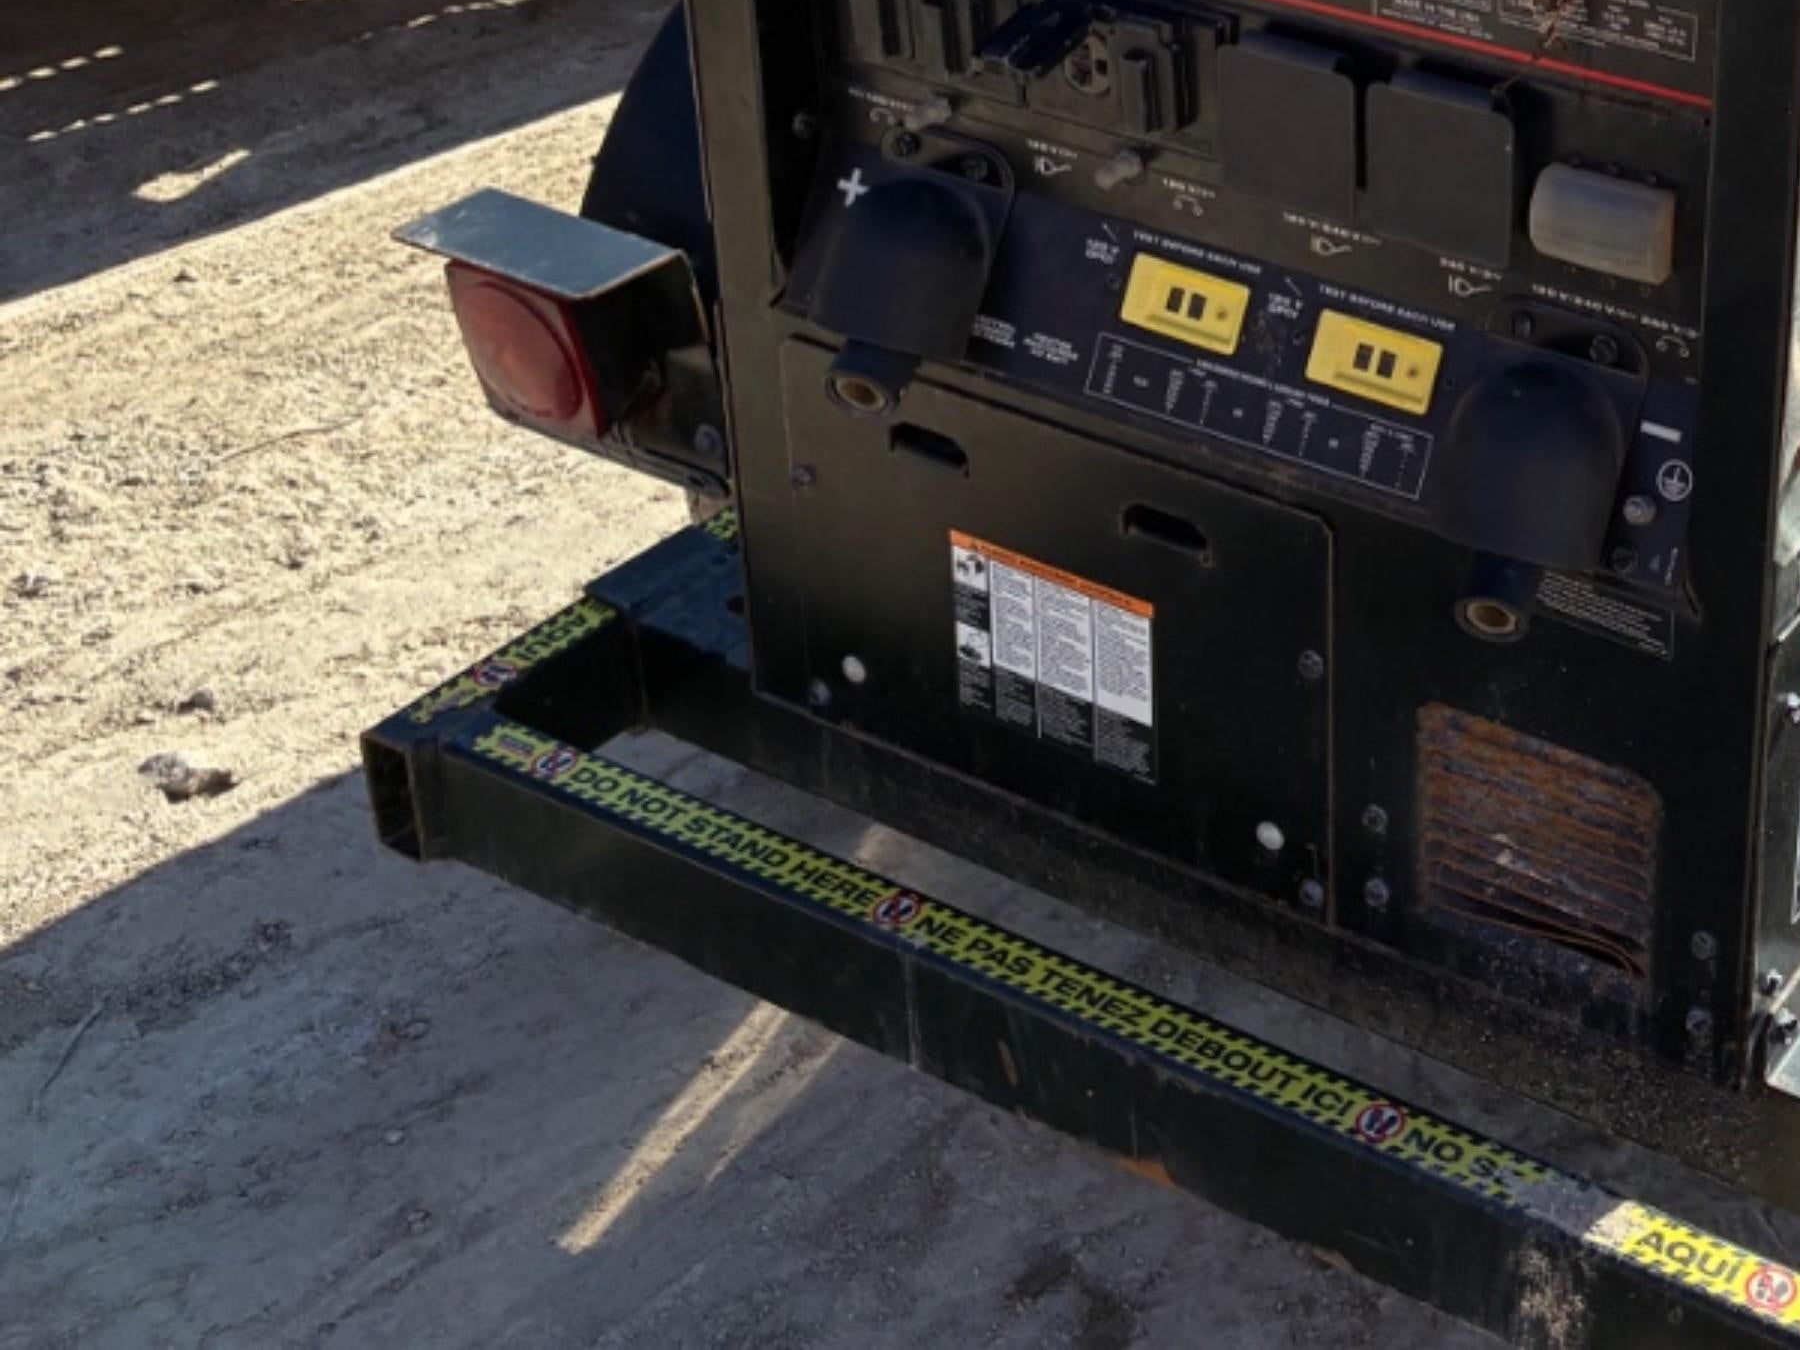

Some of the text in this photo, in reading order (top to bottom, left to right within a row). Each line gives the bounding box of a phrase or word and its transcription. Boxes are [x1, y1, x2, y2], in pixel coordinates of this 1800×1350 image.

[566, 764, 879, 906] DO NOT STAND HERE
[914, 914, 1357, 1116] NE PAS TENEZ DEBOUT ICI
[1403, 1126, 1464, 1163] NO
[1633, 1229, 1741, 1284] AQUÍ
